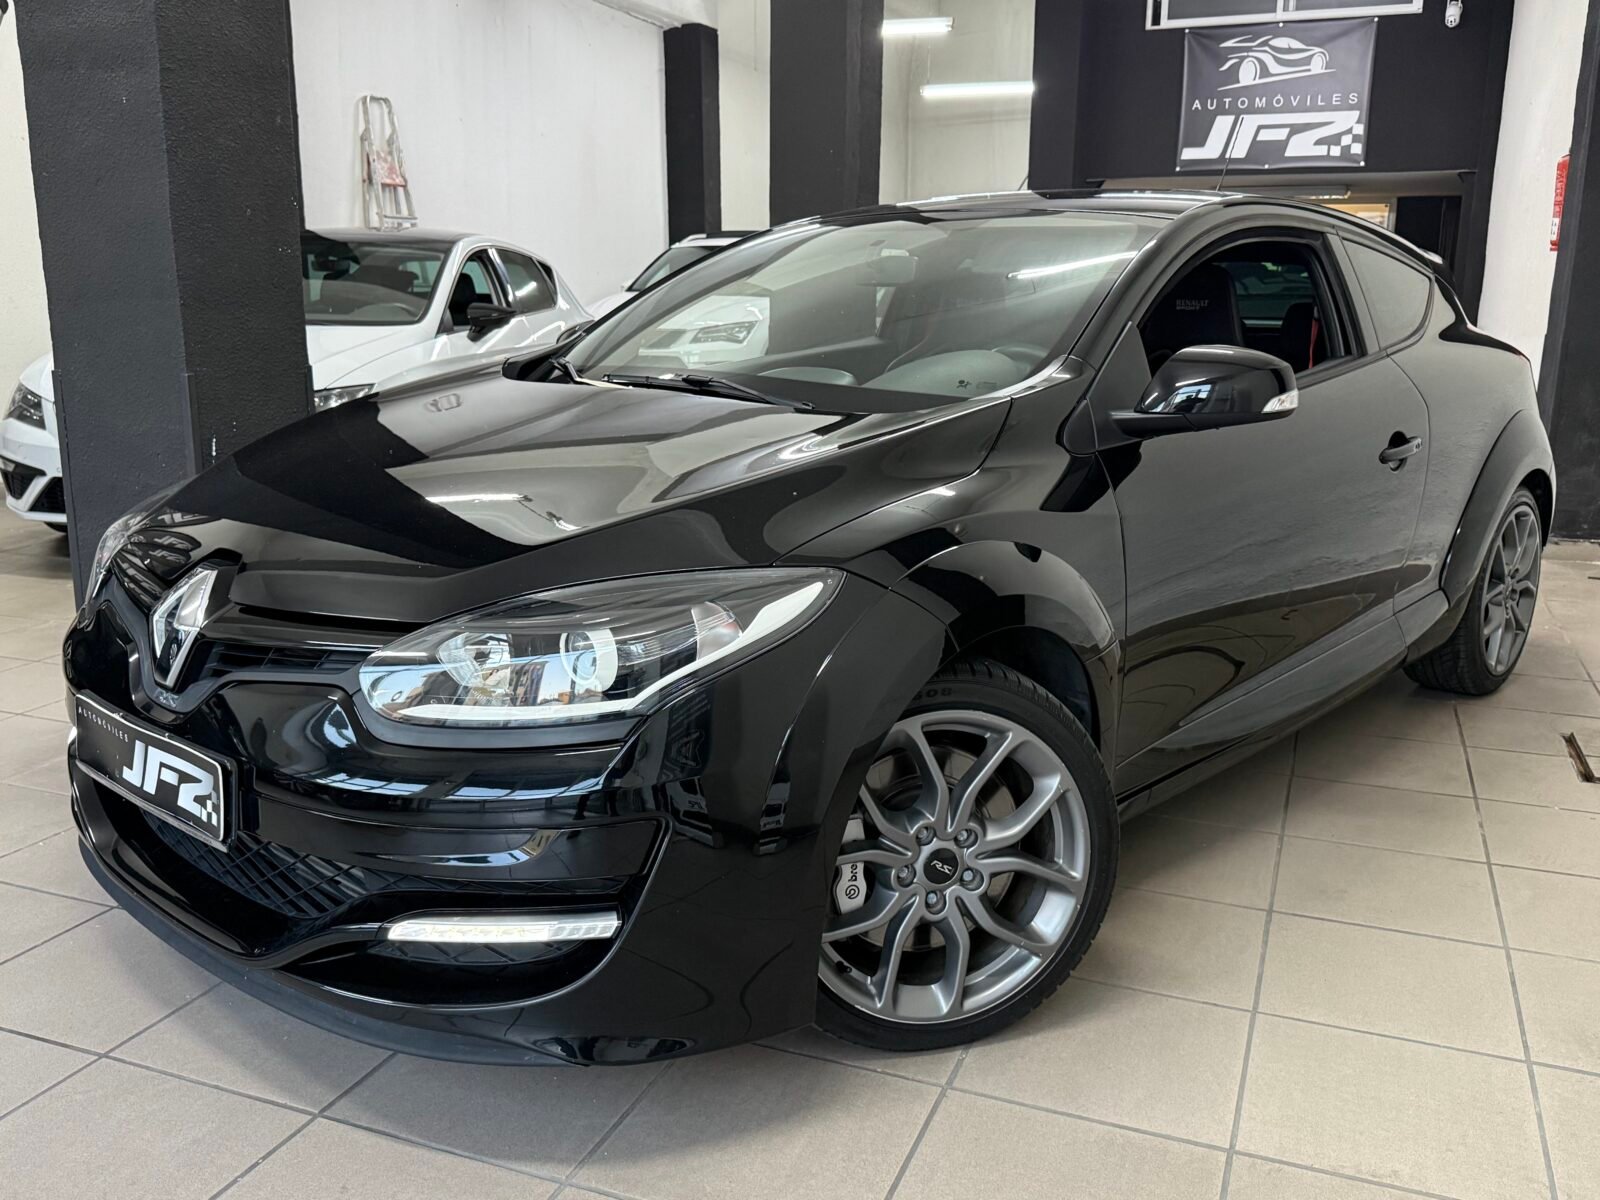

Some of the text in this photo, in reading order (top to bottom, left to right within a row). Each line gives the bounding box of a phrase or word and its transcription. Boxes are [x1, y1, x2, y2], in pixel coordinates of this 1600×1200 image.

[1192, 92, 1359, 111] AUTOMÓVILES
[847, 863, 858, 882] bre
[930, 859, 953, 874] RS
